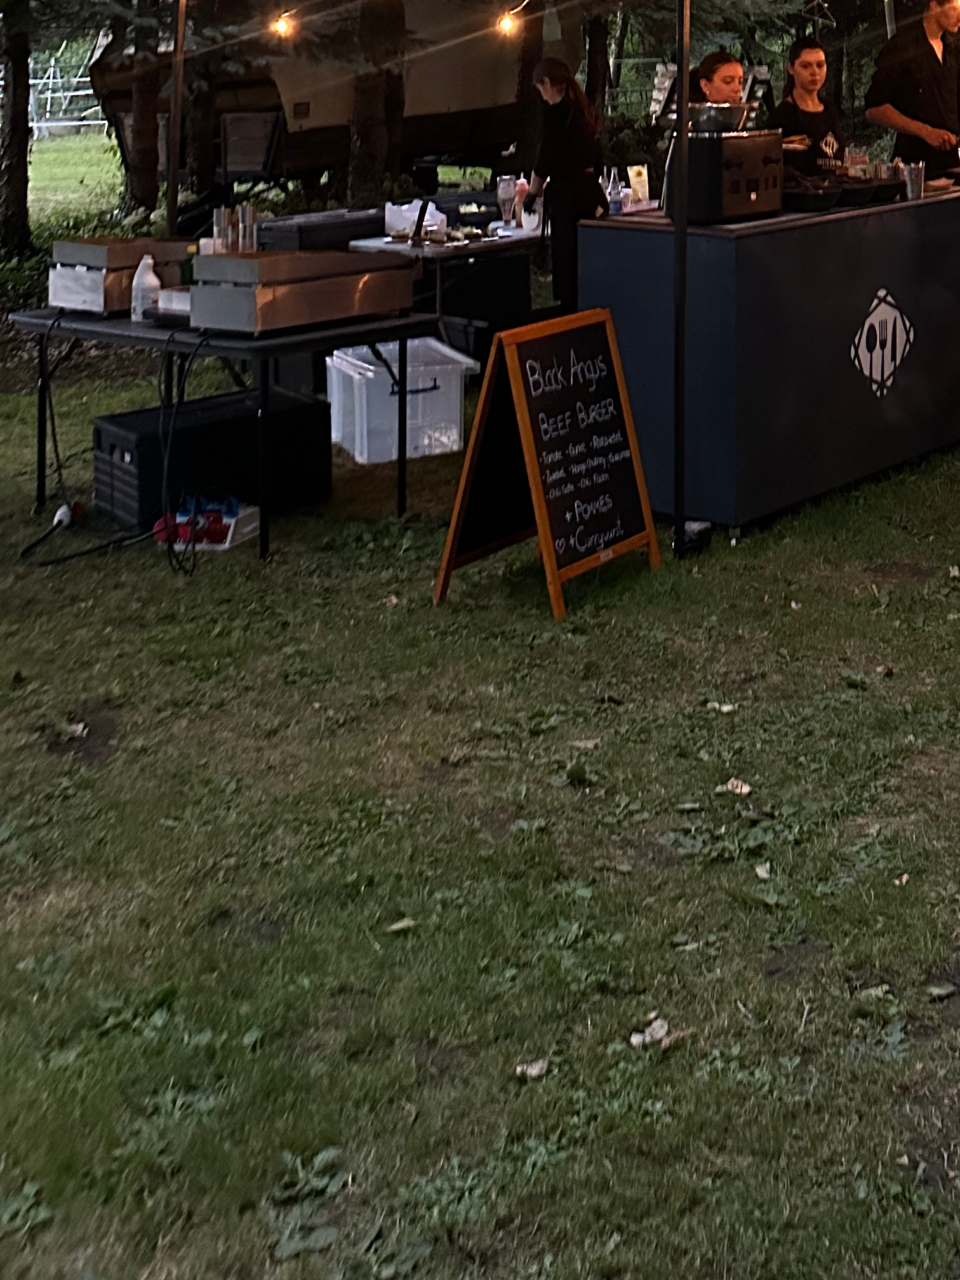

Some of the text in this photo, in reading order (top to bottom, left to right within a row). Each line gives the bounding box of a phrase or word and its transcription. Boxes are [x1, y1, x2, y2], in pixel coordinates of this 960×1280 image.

[526, 347, 608, 397] Black Angus
[539, 412, 571, 441] BEEF
[576, 398, 617, 429] BURGER
